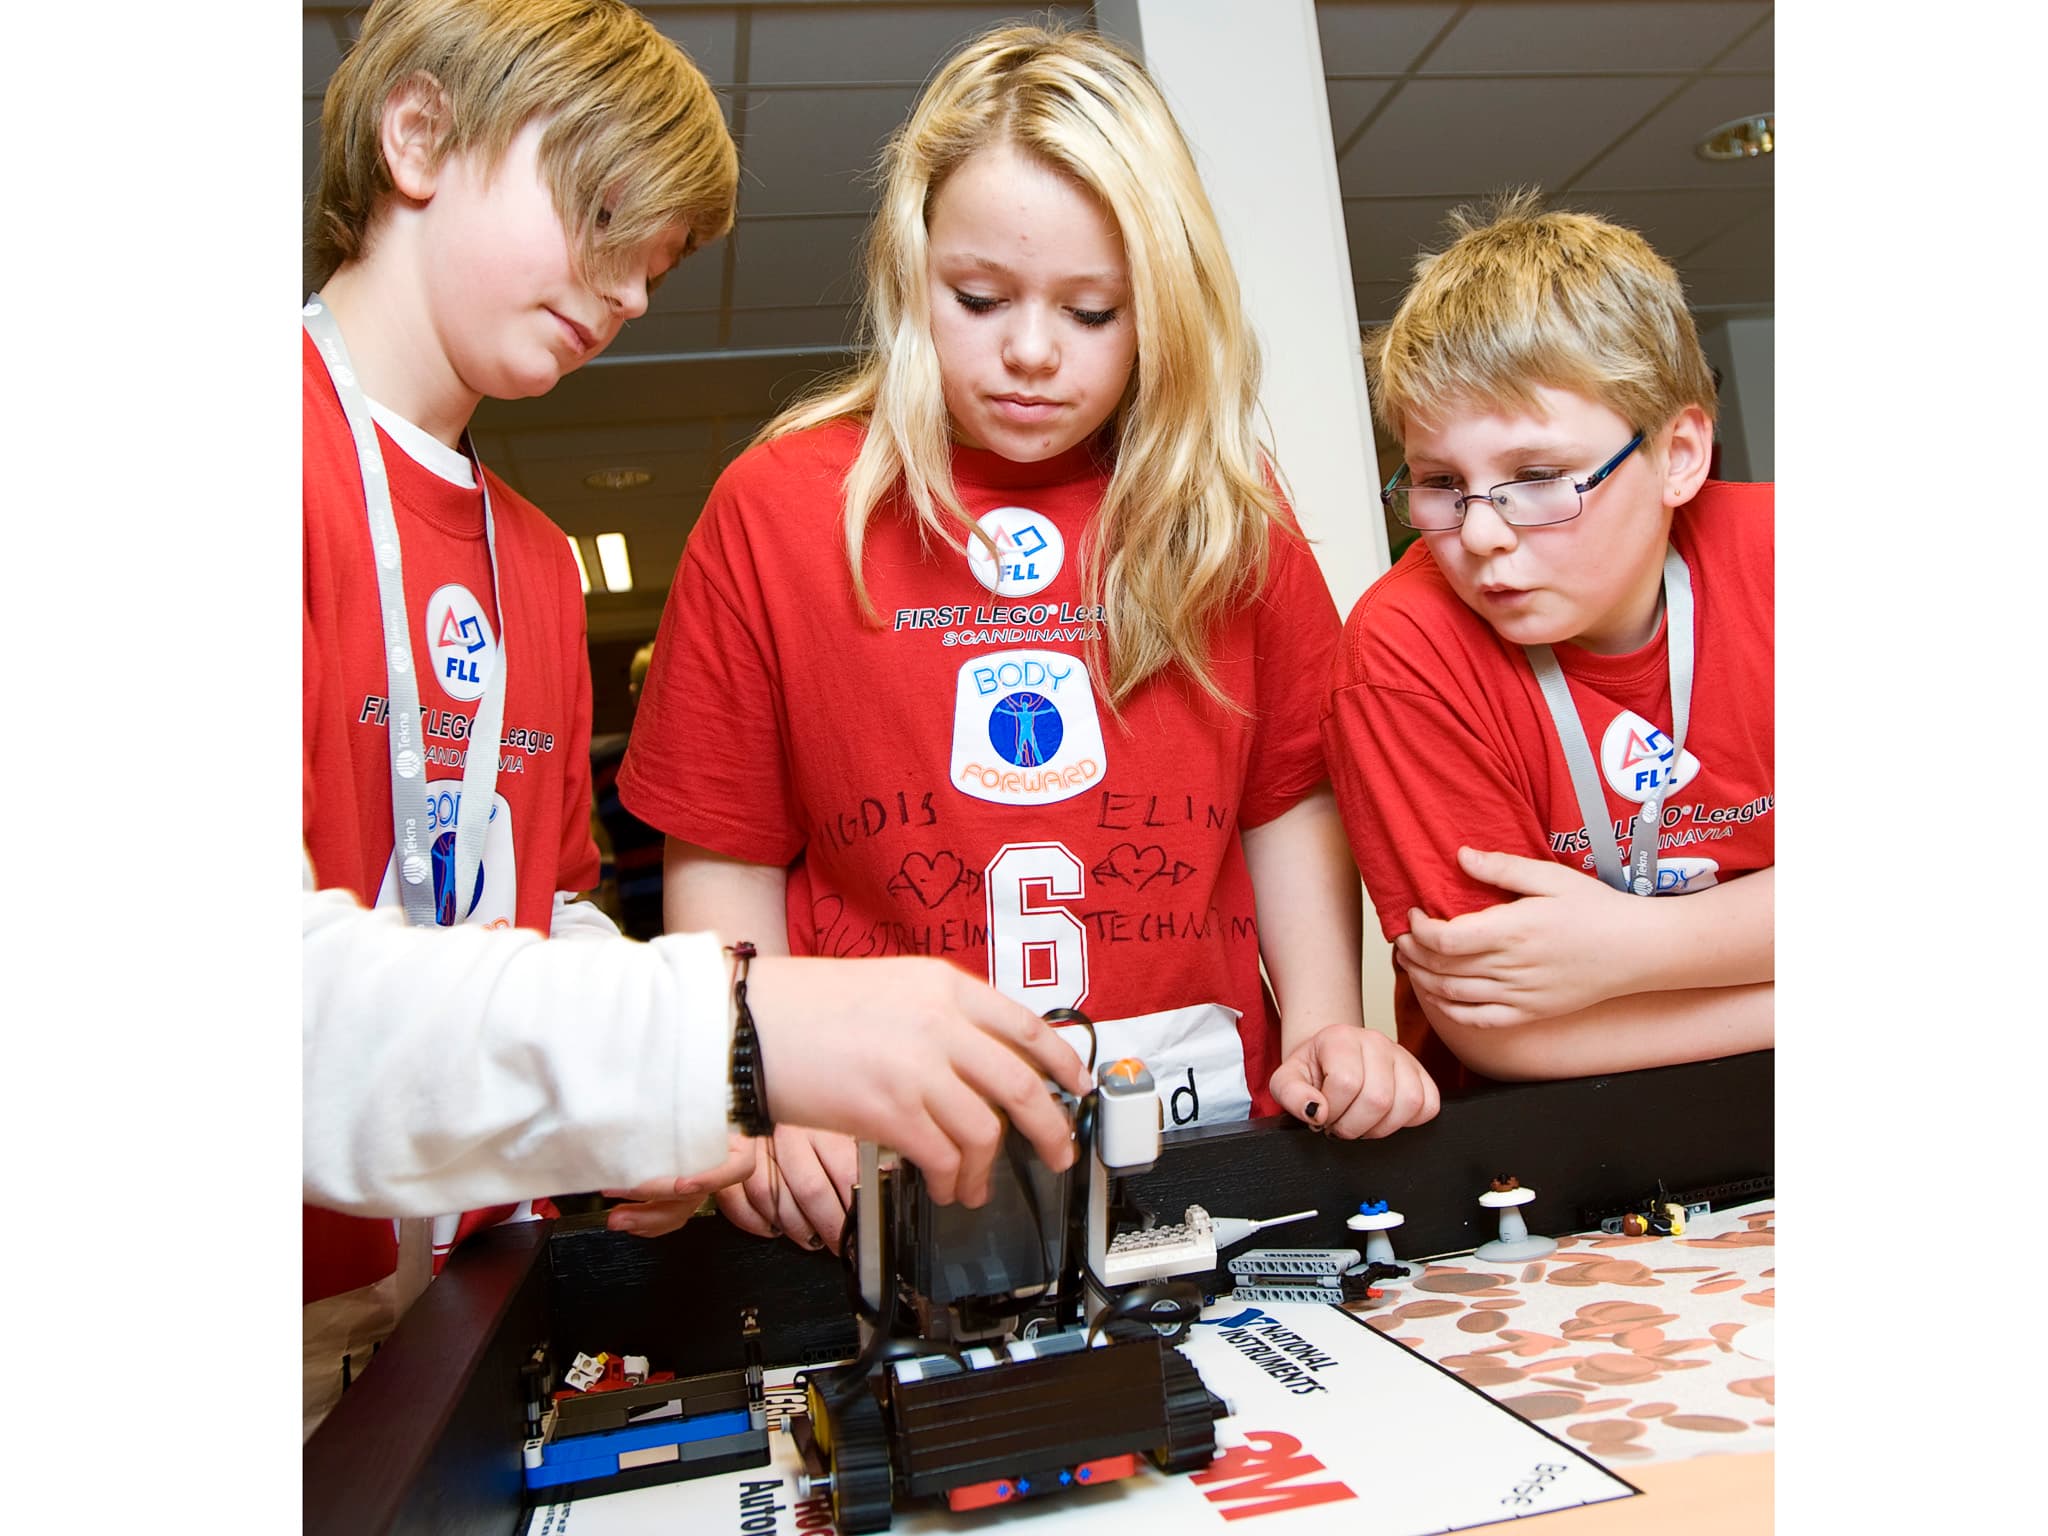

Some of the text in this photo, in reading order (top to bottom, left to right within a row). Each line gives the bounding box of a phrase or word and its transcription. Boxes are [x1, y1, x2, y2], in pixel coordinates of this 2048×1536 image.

[1000, 563, 1040, 583] FLL
[894, 604, 971, 632] FIRST
[1059, 601, 1108, 626] Lea
[942, 626, 1102, 646] SCANDINAVIA
[446, 657, 481, 684] FLL
[973, 660, 1071, 696] BODY
[397, 712, 411, 748] Tekna
[961, 758, 1099, 792] FORWARD
[818, 791, 937, 857] IGDIS
[1097, 791, 1228, 830] ELIN
[403, 817, 418, 856] Tekna
[1636, 850, 1649, 877] Tekna
[984, 841, 1089, 1012] 6
[1217, 1328, 1327, 1395] INSTRUMENTS
[1256, 1324, 1339, 1372] NATIONAL
[1188, 1429, 1359, 1522] 3M
